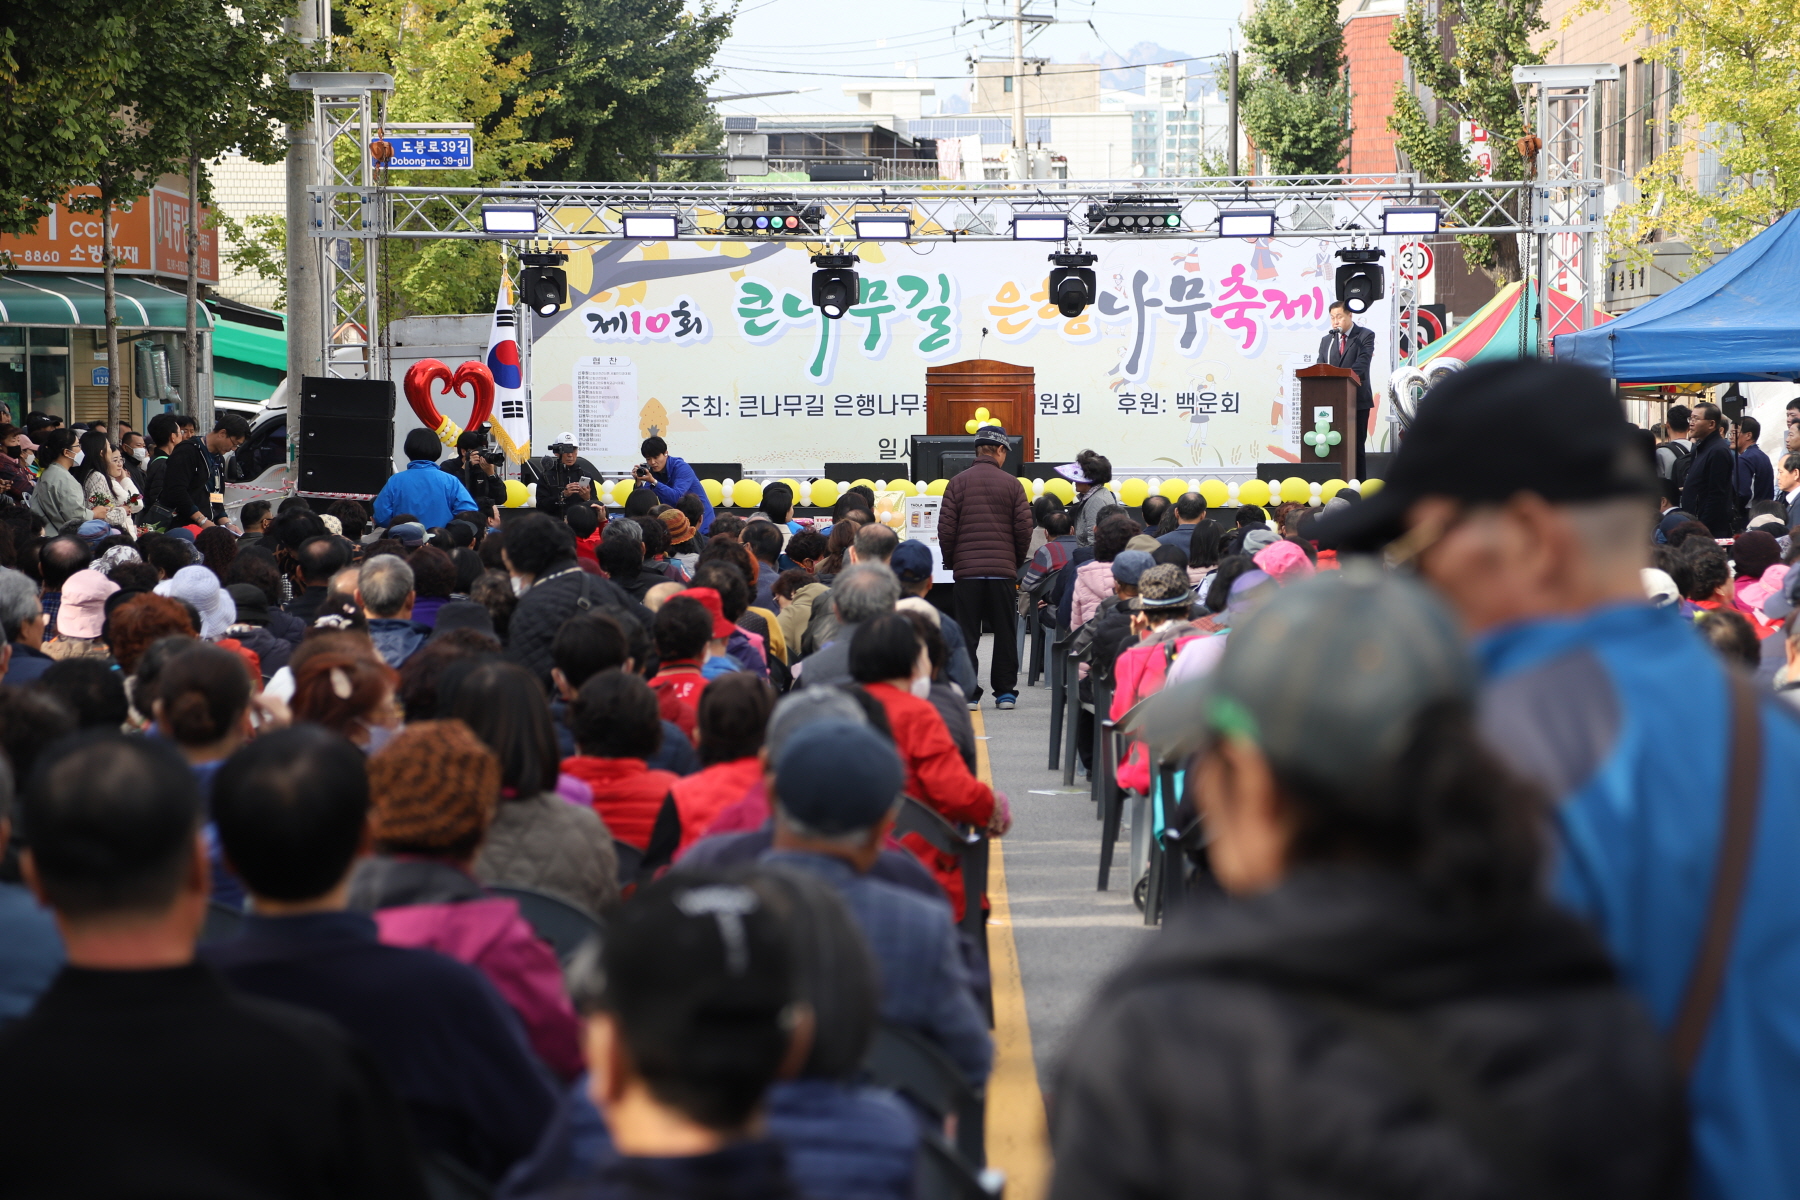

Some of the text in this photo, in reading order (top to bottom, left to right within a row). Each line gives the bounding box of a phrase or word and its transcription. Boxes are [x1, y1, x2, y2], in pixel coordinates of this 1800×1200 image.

[400, 140, 469, 154] 도봉로39길
[391, 156, 469, 167] Dobong-ro 39-gil
[0, 249, 60, 263] -8860
[1402, 252, 1425, 270] 30
[586, 300, 702, 338] 제10회
[737, 273, 951, 377] 큰나무길
[681, 391, 1240, 418] 주최: 큰나무길 은행나무 원회 후원: 백운회
